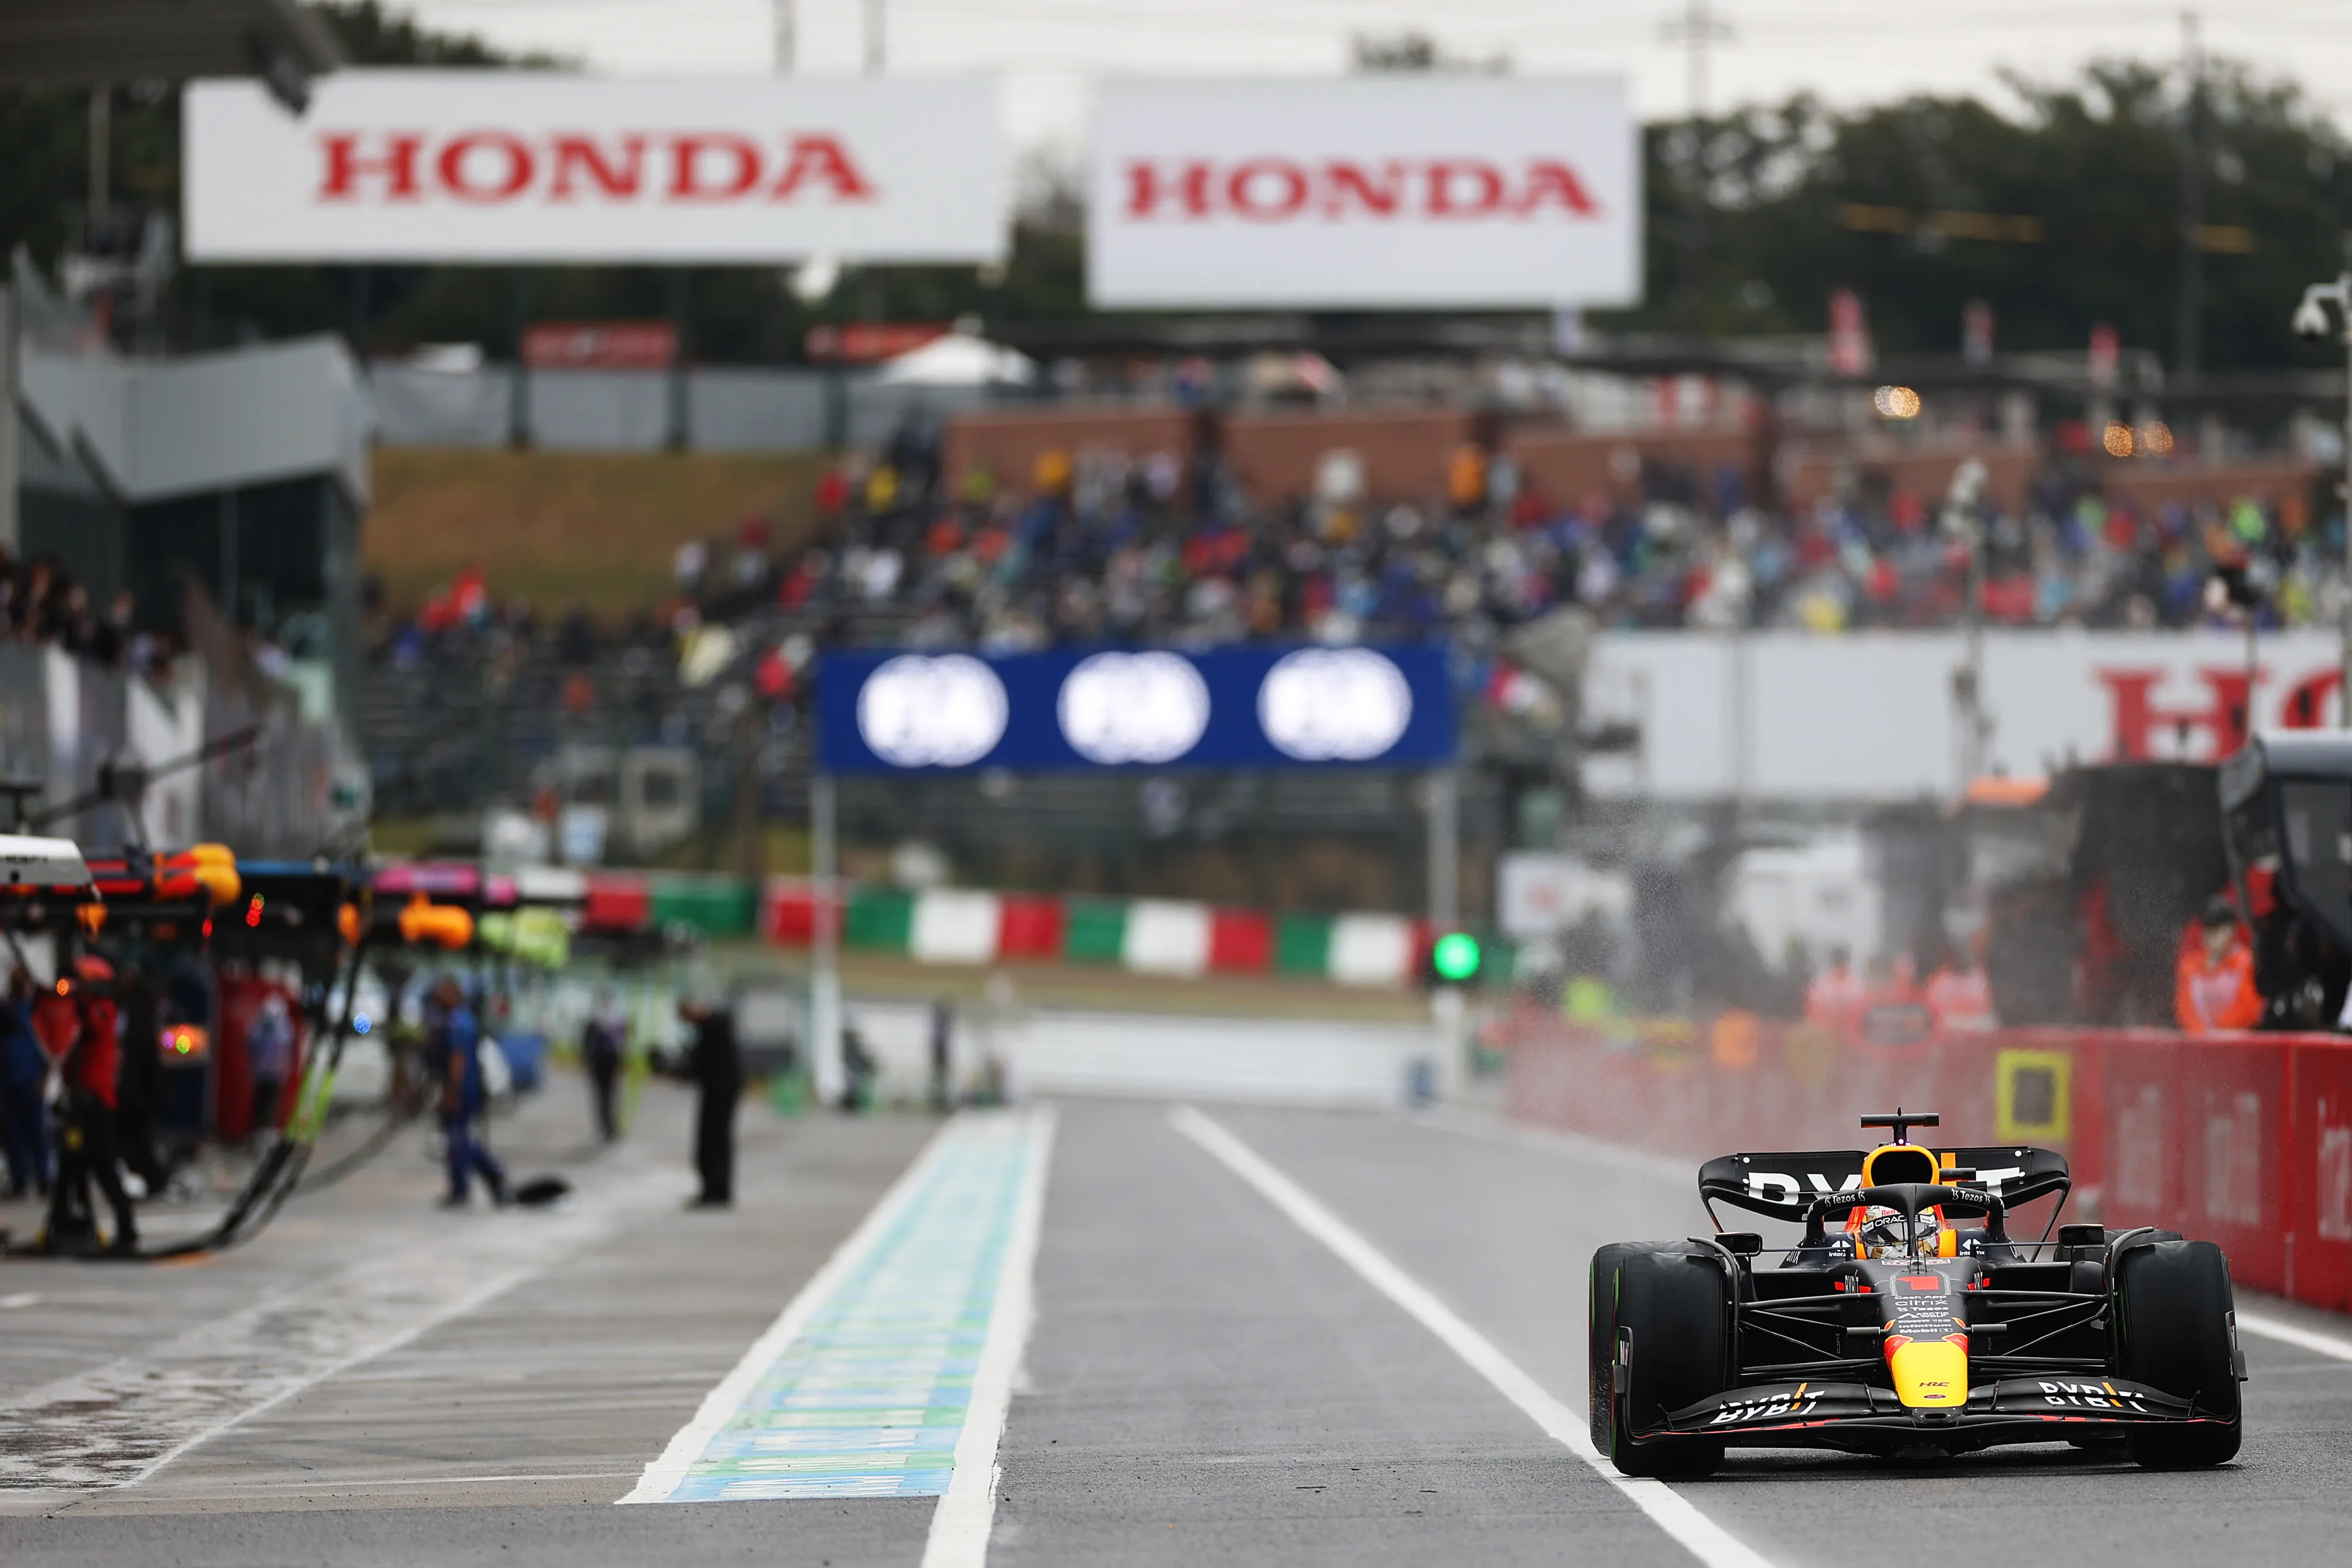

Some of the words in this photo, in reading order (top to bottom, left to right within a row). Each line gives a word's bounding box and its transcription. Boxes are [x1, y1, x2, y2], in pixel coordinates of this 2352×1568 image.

[316, 130, 876, 203] HONDA
[1126, 158, 1599, 222] HONDA
[1832, 1194, 1855, 1204] Tezos
[1960, 1191, 1983, 1202] Tezos
[1874, 1215, 1919, 1227] ORACE
[1896, 1276, 1940, 1290] 1
